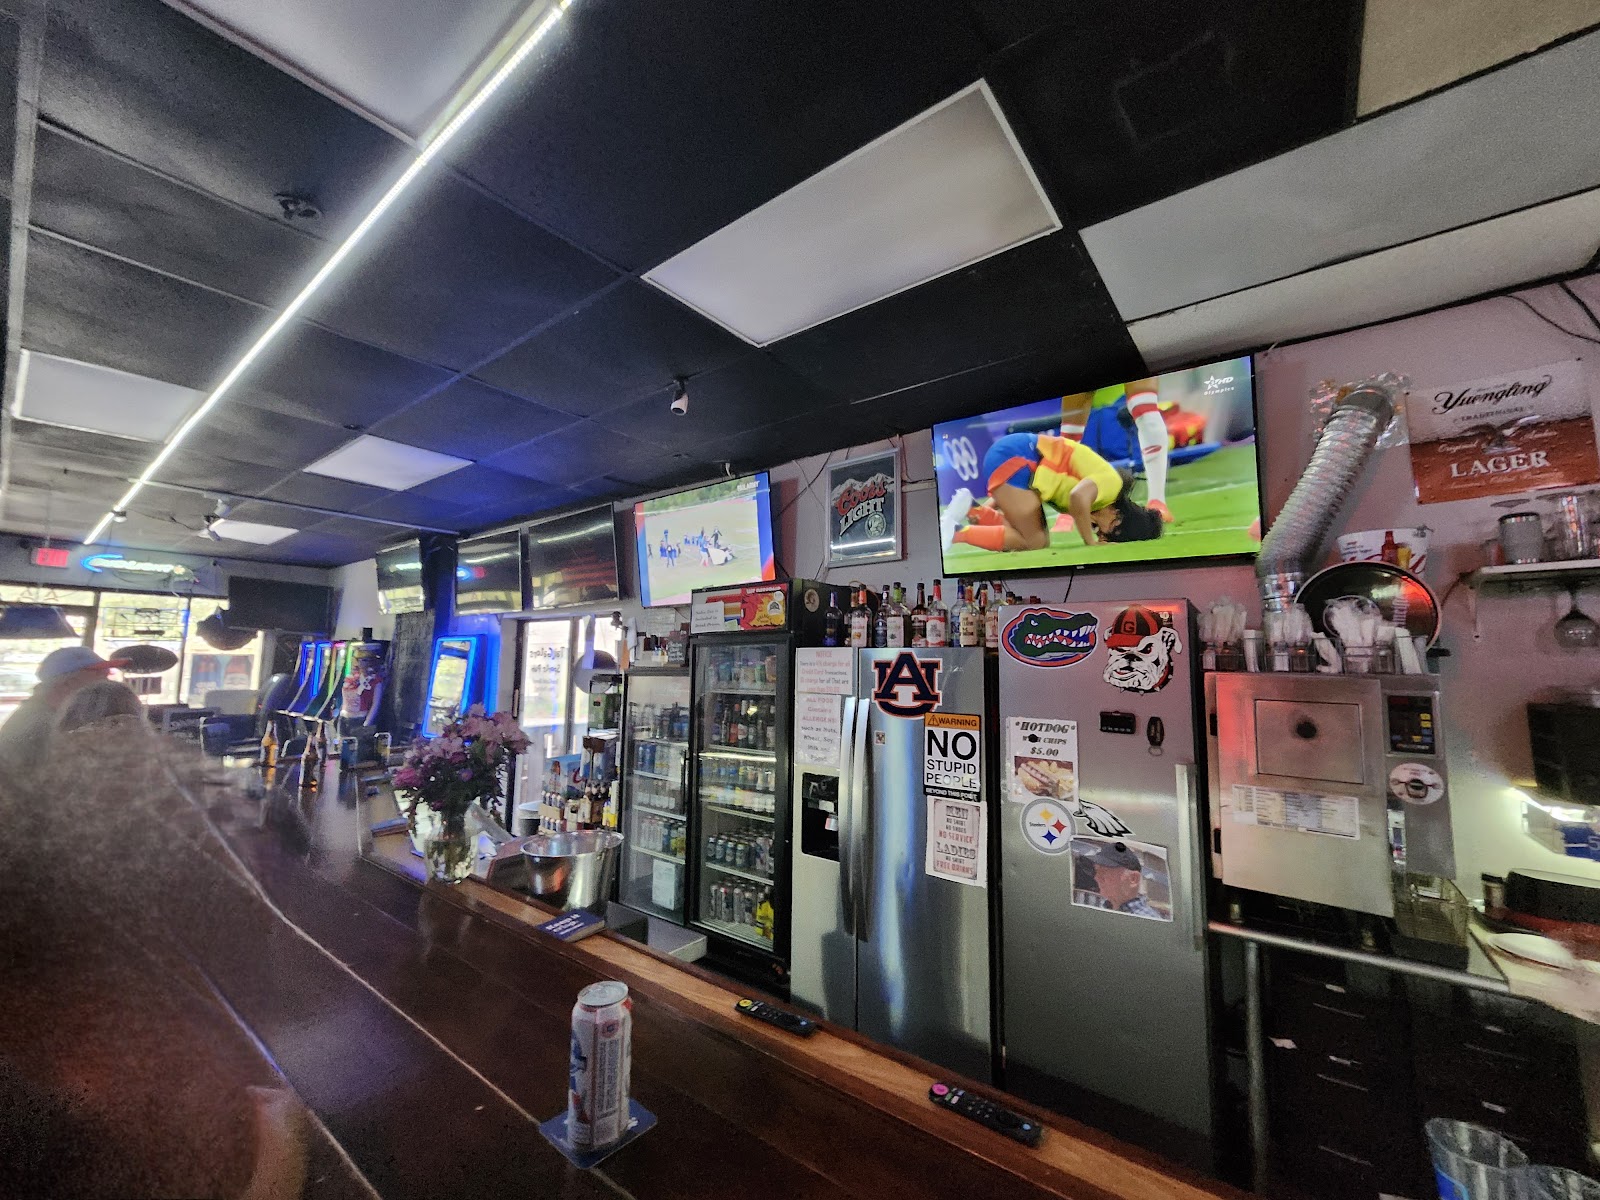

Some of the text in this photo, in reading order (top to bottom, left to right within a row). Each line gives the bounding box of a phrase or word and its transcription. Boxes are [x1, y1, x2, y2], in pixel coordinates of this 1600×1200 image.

[1203, 386, 1235, 396] Olympics
[1431, 374, 1553, 415] Yuengling
[1450, 450, 1551, 478] LAGER
[834, 480, 887, 516] Coors
[839, 497, 885, 536] LIGHT
[1123, 621, 1135, 633] G
[815, 650, 832, 658] NOTICE
[807, 706, 832, 714] Contains
[939, 717, 977, 727] WARNING
[927, 729, 977, 760] NO
[1043, 737, 1067, 745] CHIPS
[1030, 746, 1059, 757] $5.00
[926, 759, 977, 775] STUPID
[926, 772, 977, 789] PEOPLE
[926, 787, 947, 796] BEYOND
[961, 792, 978, 801] POINT
[946, 805, 969, 820] MEN
[953, 819, 966, 827] SHIRT
[953, 825, 967, 833] SHOES
[938, 830, 974, 844] NO SERVICE
[936, 841, 976, 860] LADIES
[952, 856, 965, 864] SHIRT
[936, 860, 974, 875] FREE DRINKS
